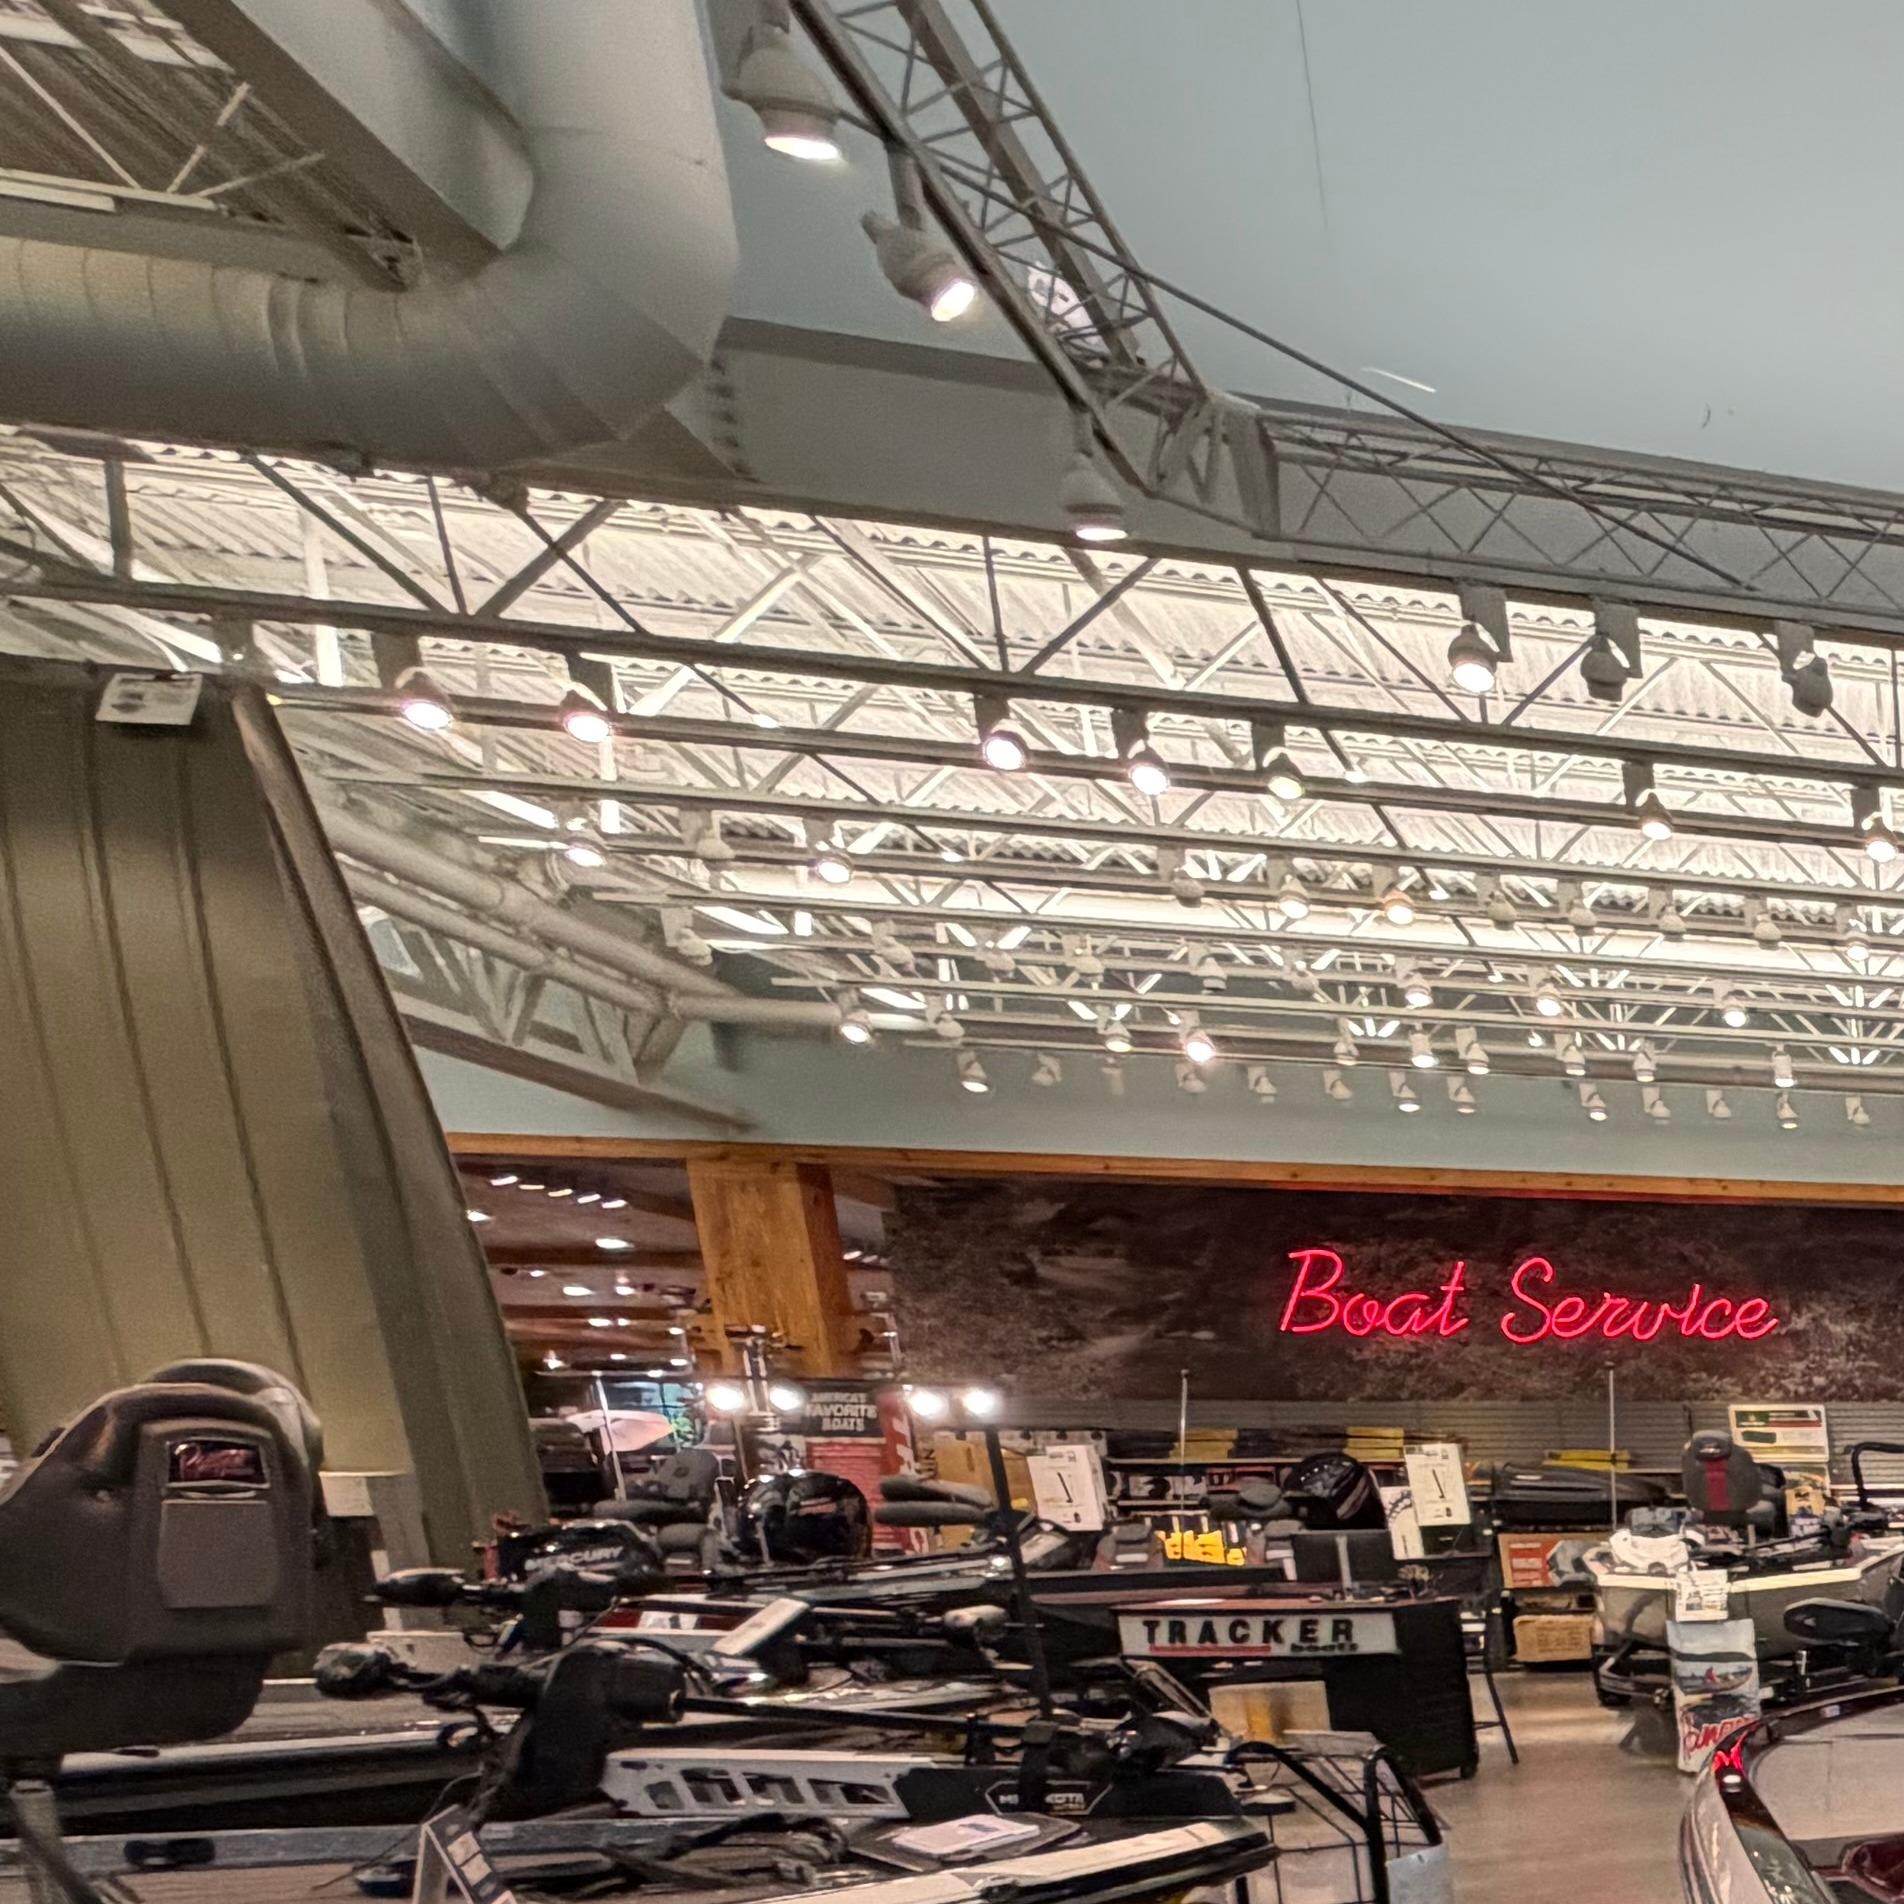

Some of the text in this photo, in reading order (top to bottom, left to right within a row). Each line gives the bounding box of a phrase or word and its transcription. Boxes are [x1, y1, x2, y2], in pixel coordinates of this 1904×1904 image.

[1279, 1248, 1779, 1344] Boat Service
[806, 1403, 877, 1418] FAVORITE
[821, 1418, 865, 1431] BOATS
[1142, 1618, 1354, 1644] TRACKER
